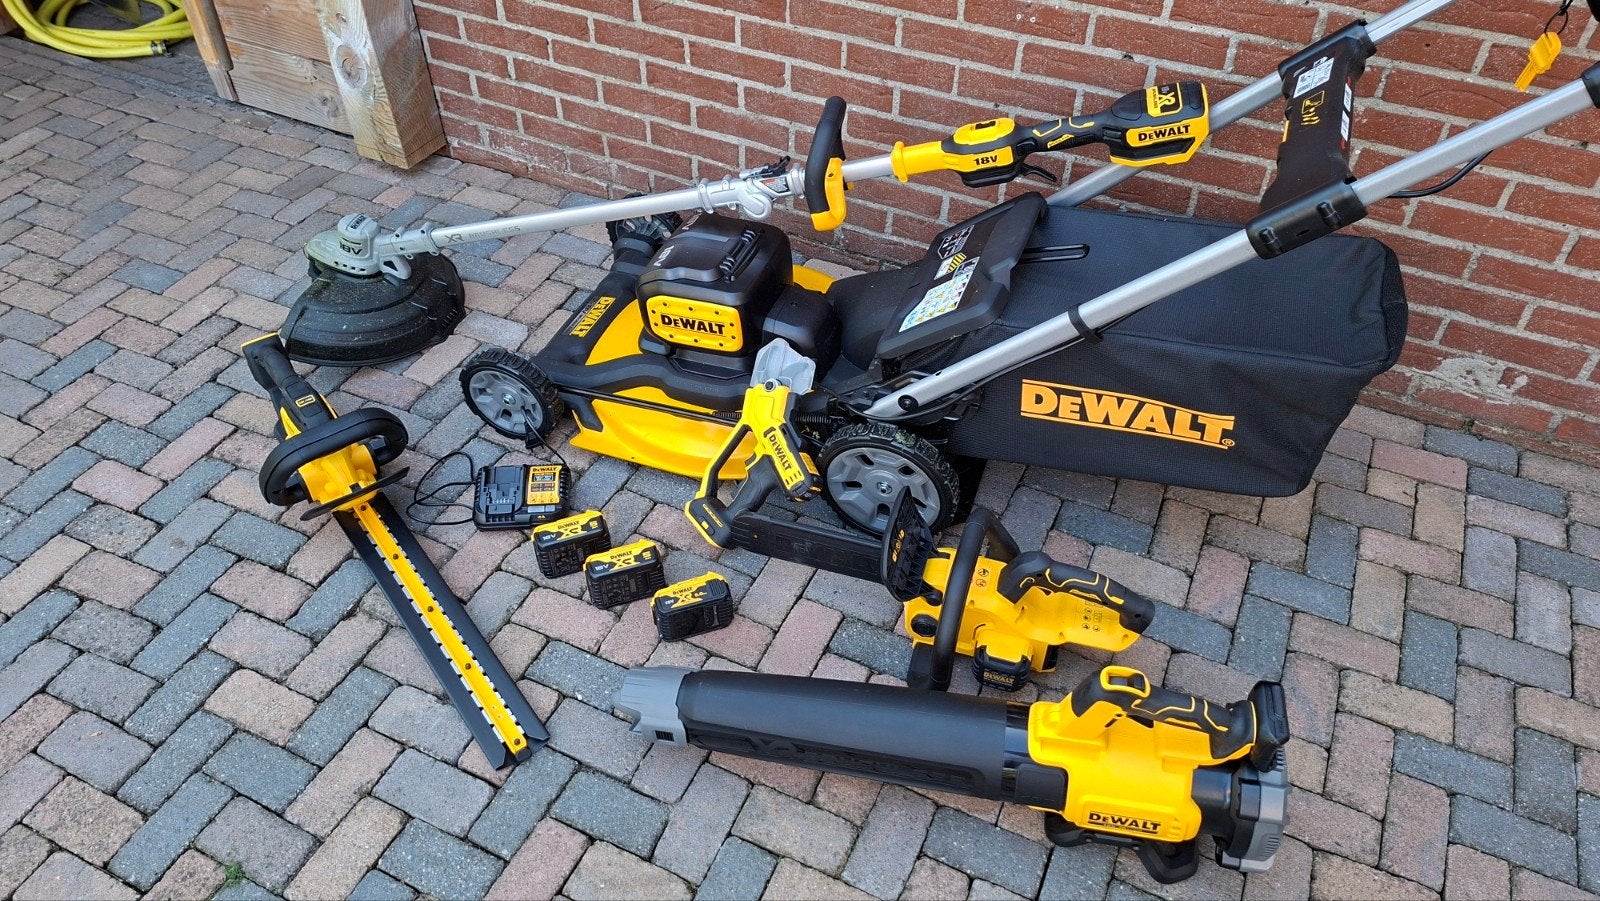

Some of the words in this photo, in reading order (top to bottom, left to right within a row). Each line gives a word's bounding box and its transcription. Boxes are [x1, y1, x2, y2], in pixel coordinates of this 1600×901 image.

[1138, 125, 1190, 141] DEWALT
[974, 155, 998, 165] 18V
[445, 233, 464, 243] XR
[570, 296, 616, 337] DEWALT
[660, 314, 726, 335] DEWALT
[1021, 383, 1235, 444] DEWALT
[768, 432, 793, 471] DEWALT
[983, 671, 1014, 685] DEWALT
[1088, 812, 1161, 831] DEWALT
